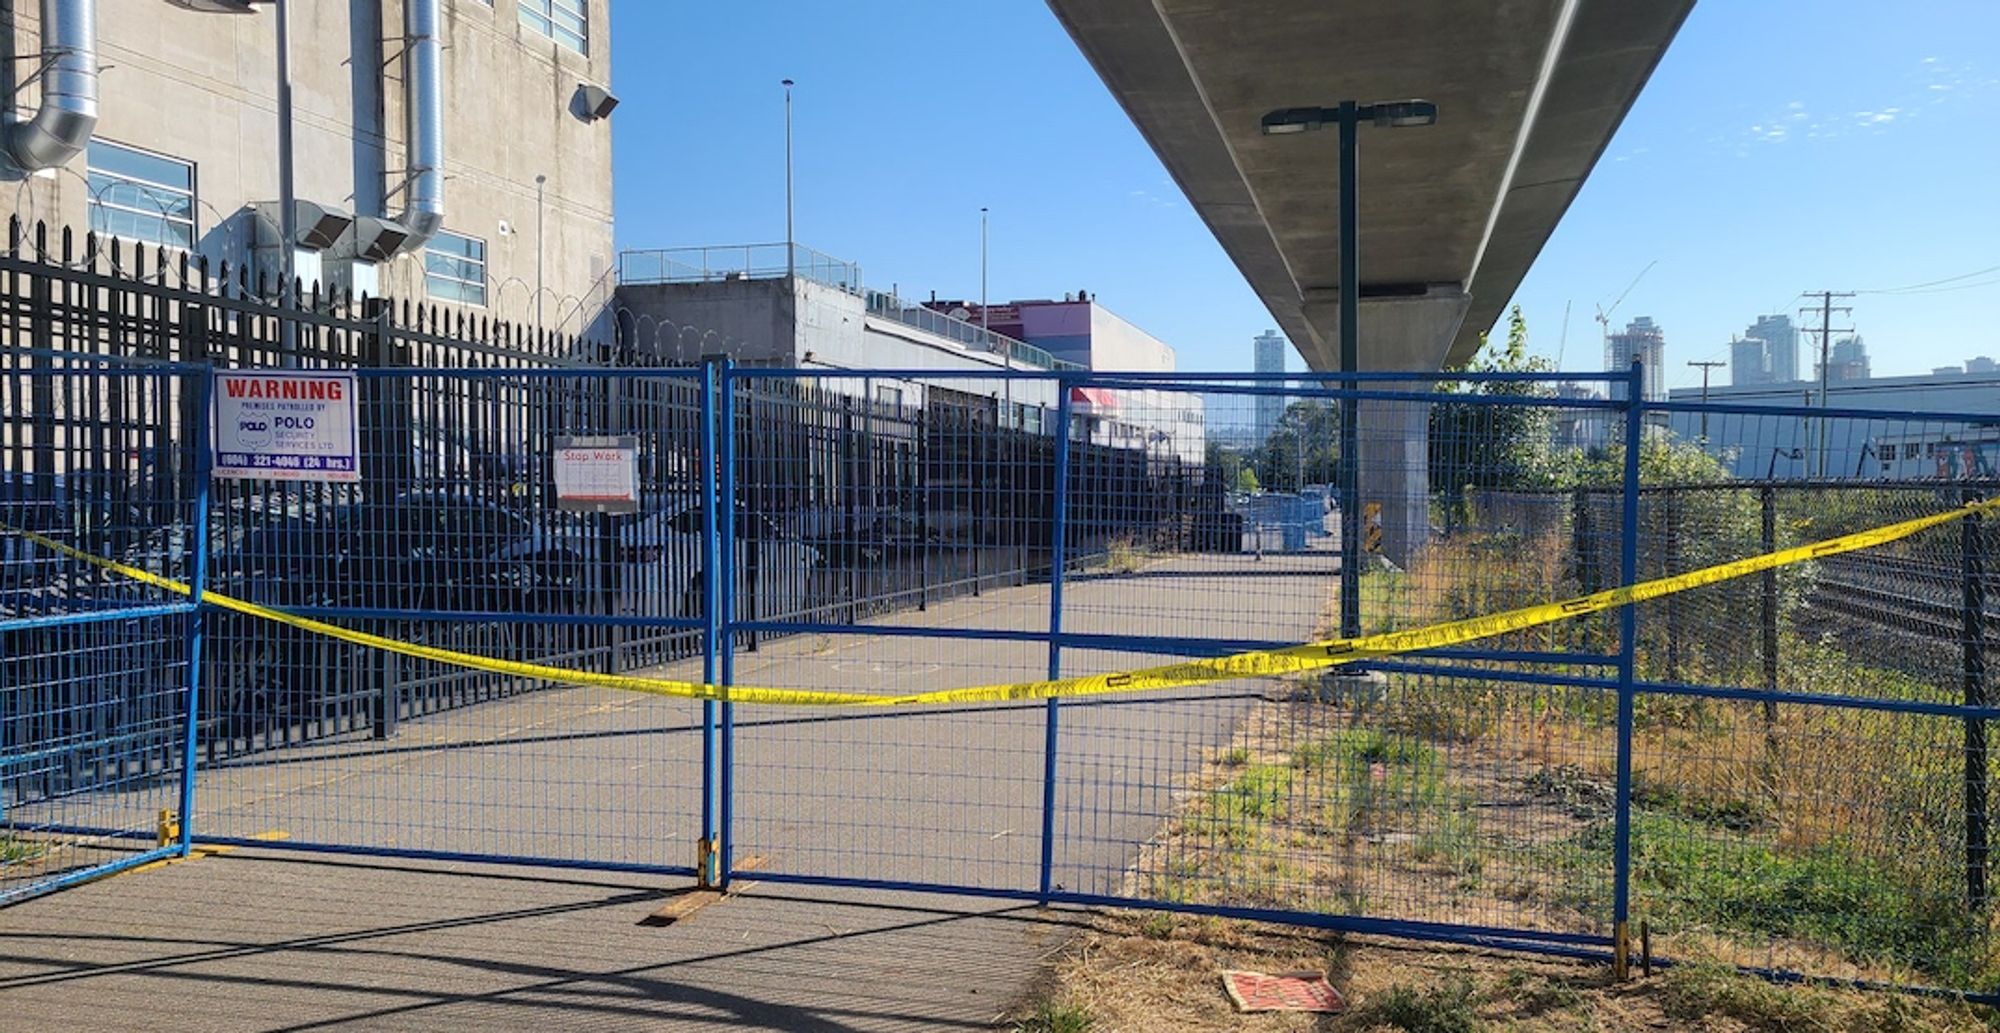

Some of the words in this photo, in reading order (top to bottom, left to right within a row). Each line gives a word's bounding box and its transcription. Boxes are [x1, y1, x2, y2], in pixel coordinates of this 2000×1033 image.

[226, 379, 342, 400] WARNING
[241, 402, 274, 410] PREMISES
[240, 421, 267, 431] POLO
[275, 417, 314, 429] POLO
[275, 441, 315, 449] SERVICES
[564, 451, 589, 462] Stop
[594, 451, 623, 461] Work
